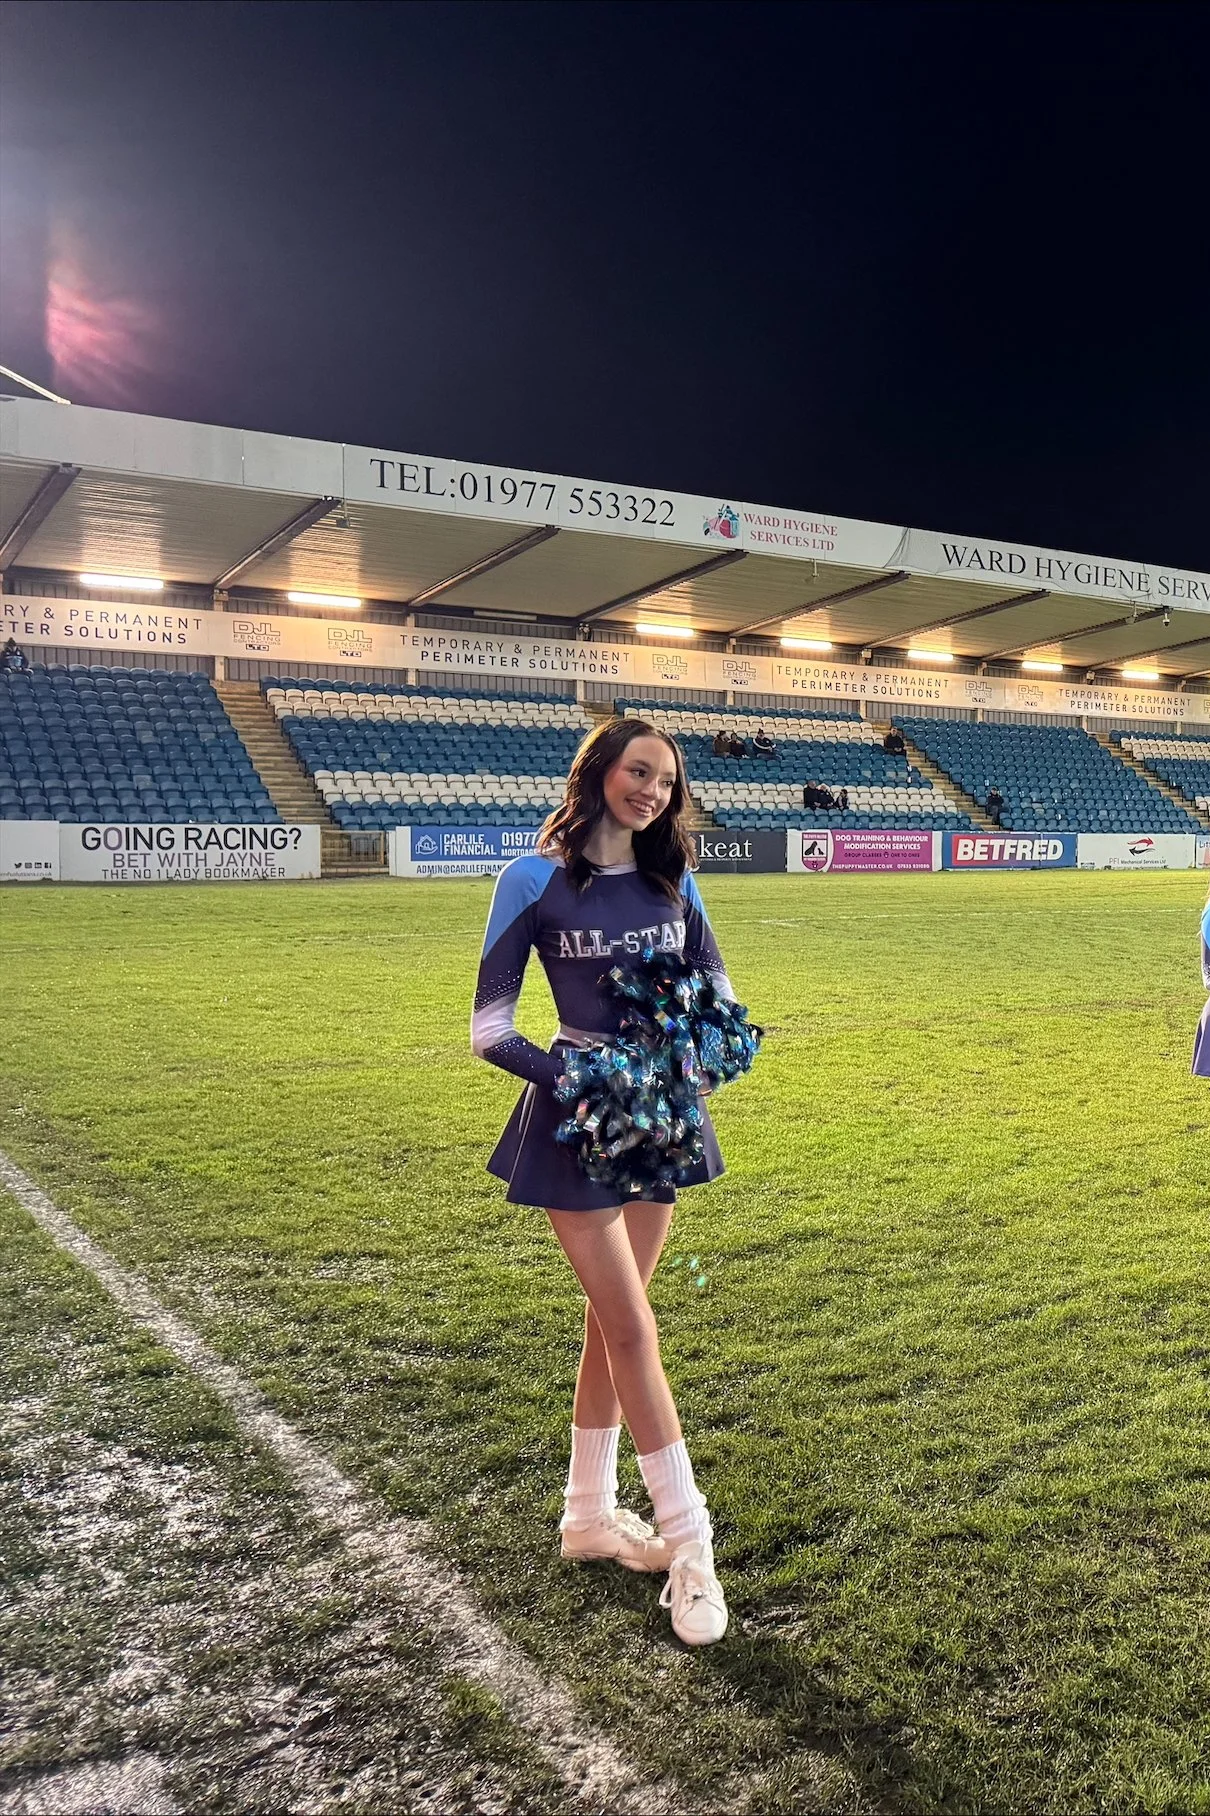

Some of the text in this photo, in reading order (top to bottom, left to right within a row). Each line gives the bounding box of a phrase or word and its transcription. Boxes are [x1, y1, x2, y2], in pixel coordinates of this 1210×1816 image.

[369, 458, 676, 527] TEL:01977 553322
[744, 513, 838, 537] WARD HYGIENE
[750, 530, 835, 551] SERVICES LTD
[941, 543, 1027, 575] WARD
[1034, 557, 1151, 593] HYGIENE
[44, 607, 55, 620] &
[70, 609, 202, 631] PERMANENT
[64, 625, 187, 645] SOLUTIONS
[233, 620, 281, 636] DJL
[328, 627, 373, 643] DJL
[233, 634, 281, 642] FENCING
[328, 640, 373, 649] FENCING
[400, 634, 630, 662] TEMPORARY & PERMANENT
[421, 650, 619, 675] PERIMETER SOLUTIONS
[652, 653, 688, 668] DJL
[722, 659, 757, 674] DJL
[776, 665, 950, 689] TEMPORARY & PERMANENT
[792, 679, 941, 698] PERIMETER SOLUTIONS
[965, 680, 993, 692] DJL
[1018, 684, 1044, 695] DJL
[1059, 688, 1118, 702] TEMPORARY
[1134, 695, 1191, 707] PERMANENT
[1070, 700, 1185, 716] PERIMETER SOLUTIONS
[81, 826, 302, 851] GOING RACING?
[444, 831, 536, 847] CARLILE 01977
[699, 834, 753, 858] keat
[444, 844, 497, 856] FINANCIAL
[956, 838, 1064, 861] BETFRED
[113, 852, 275, 868] BET WITH JAYNE
[102, 868, 130, 879] THE
[133, 868, 151, 879] NO
[166, 868, 200, 879] LADY
[204, 867, 286, 878] BOOKMAKER
[416, 864, 503, 875] ADMIN@CARLILEFINAN
